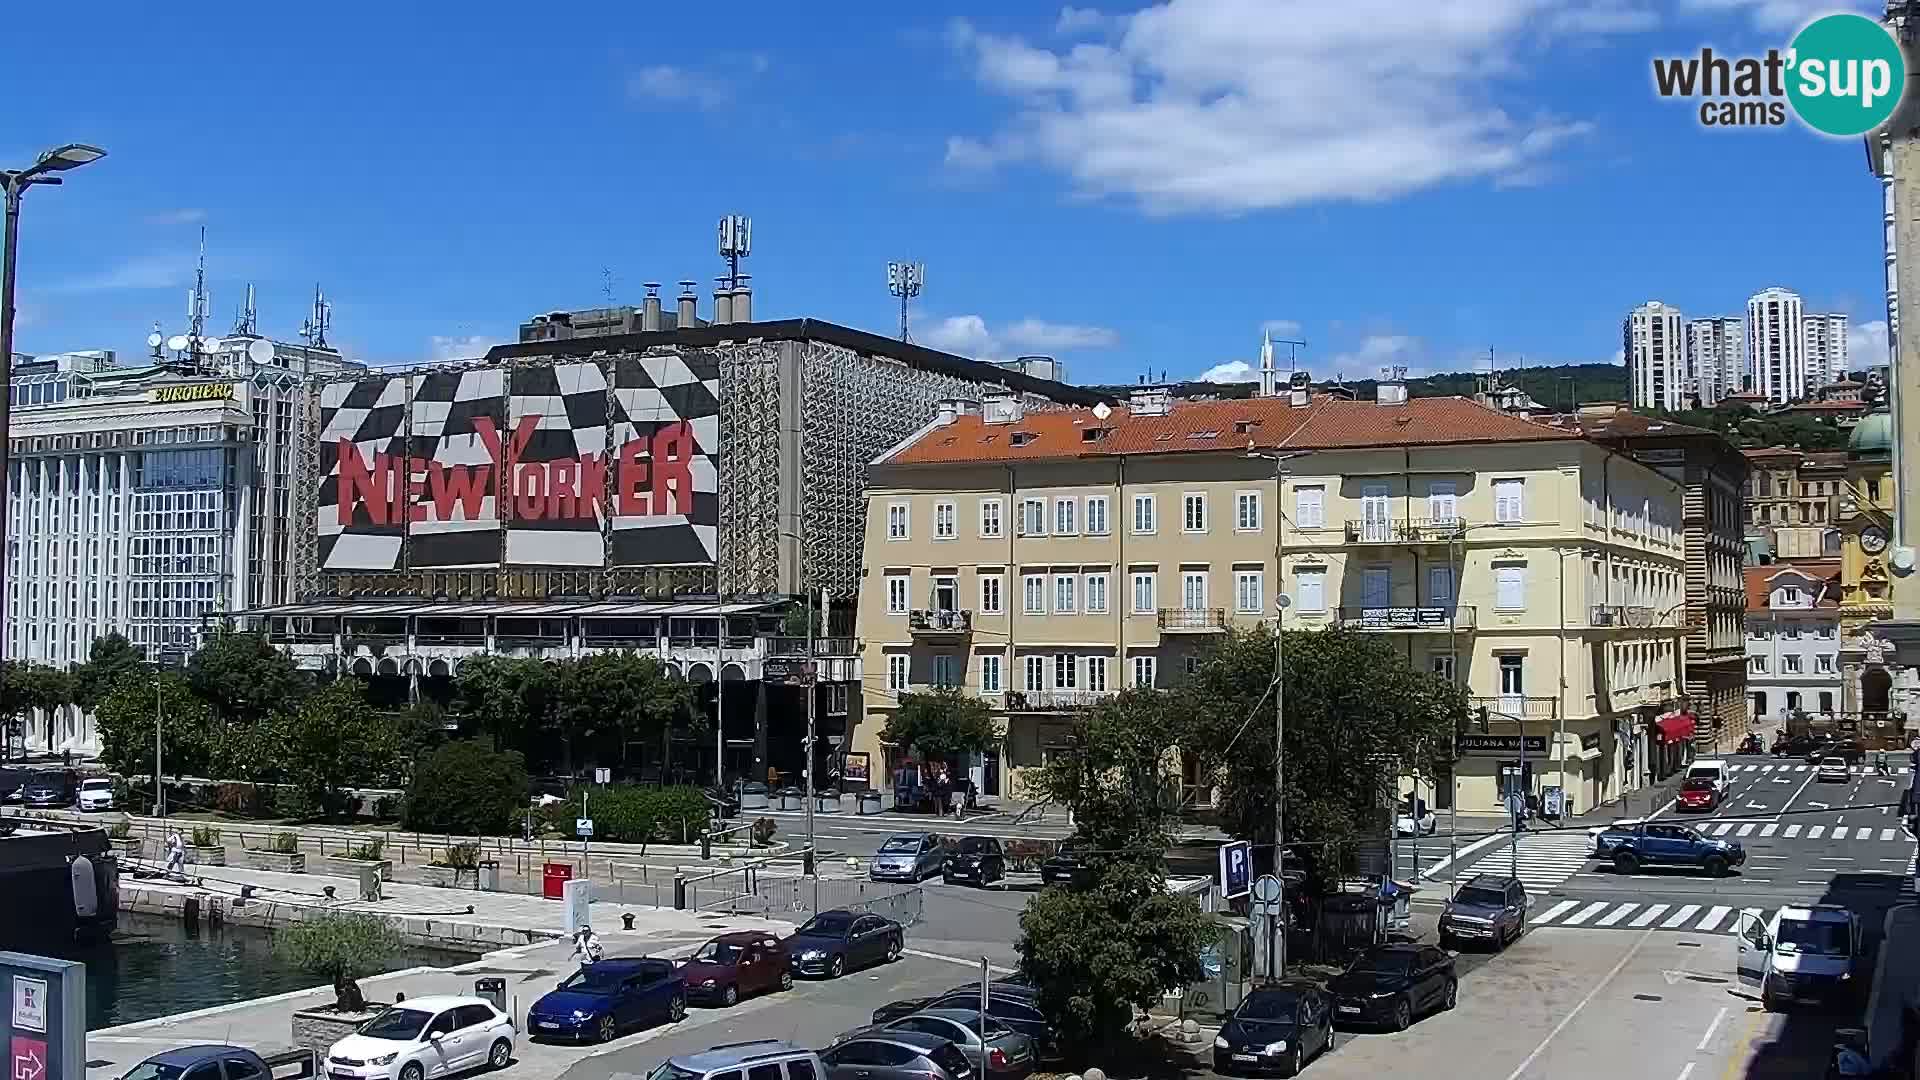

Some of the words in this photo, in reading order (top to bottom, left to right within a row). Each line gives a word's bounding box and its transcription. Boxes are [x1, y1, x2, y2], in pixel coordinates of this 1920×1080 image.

[337, 435, 491, 527] NEW
[470, 414, 694, 520] YORKER
[1459, 739, 1505, 748] JULIANA
[1508, 739, 1541, 748] NALS
[1231, 849, 1243, 873] P
